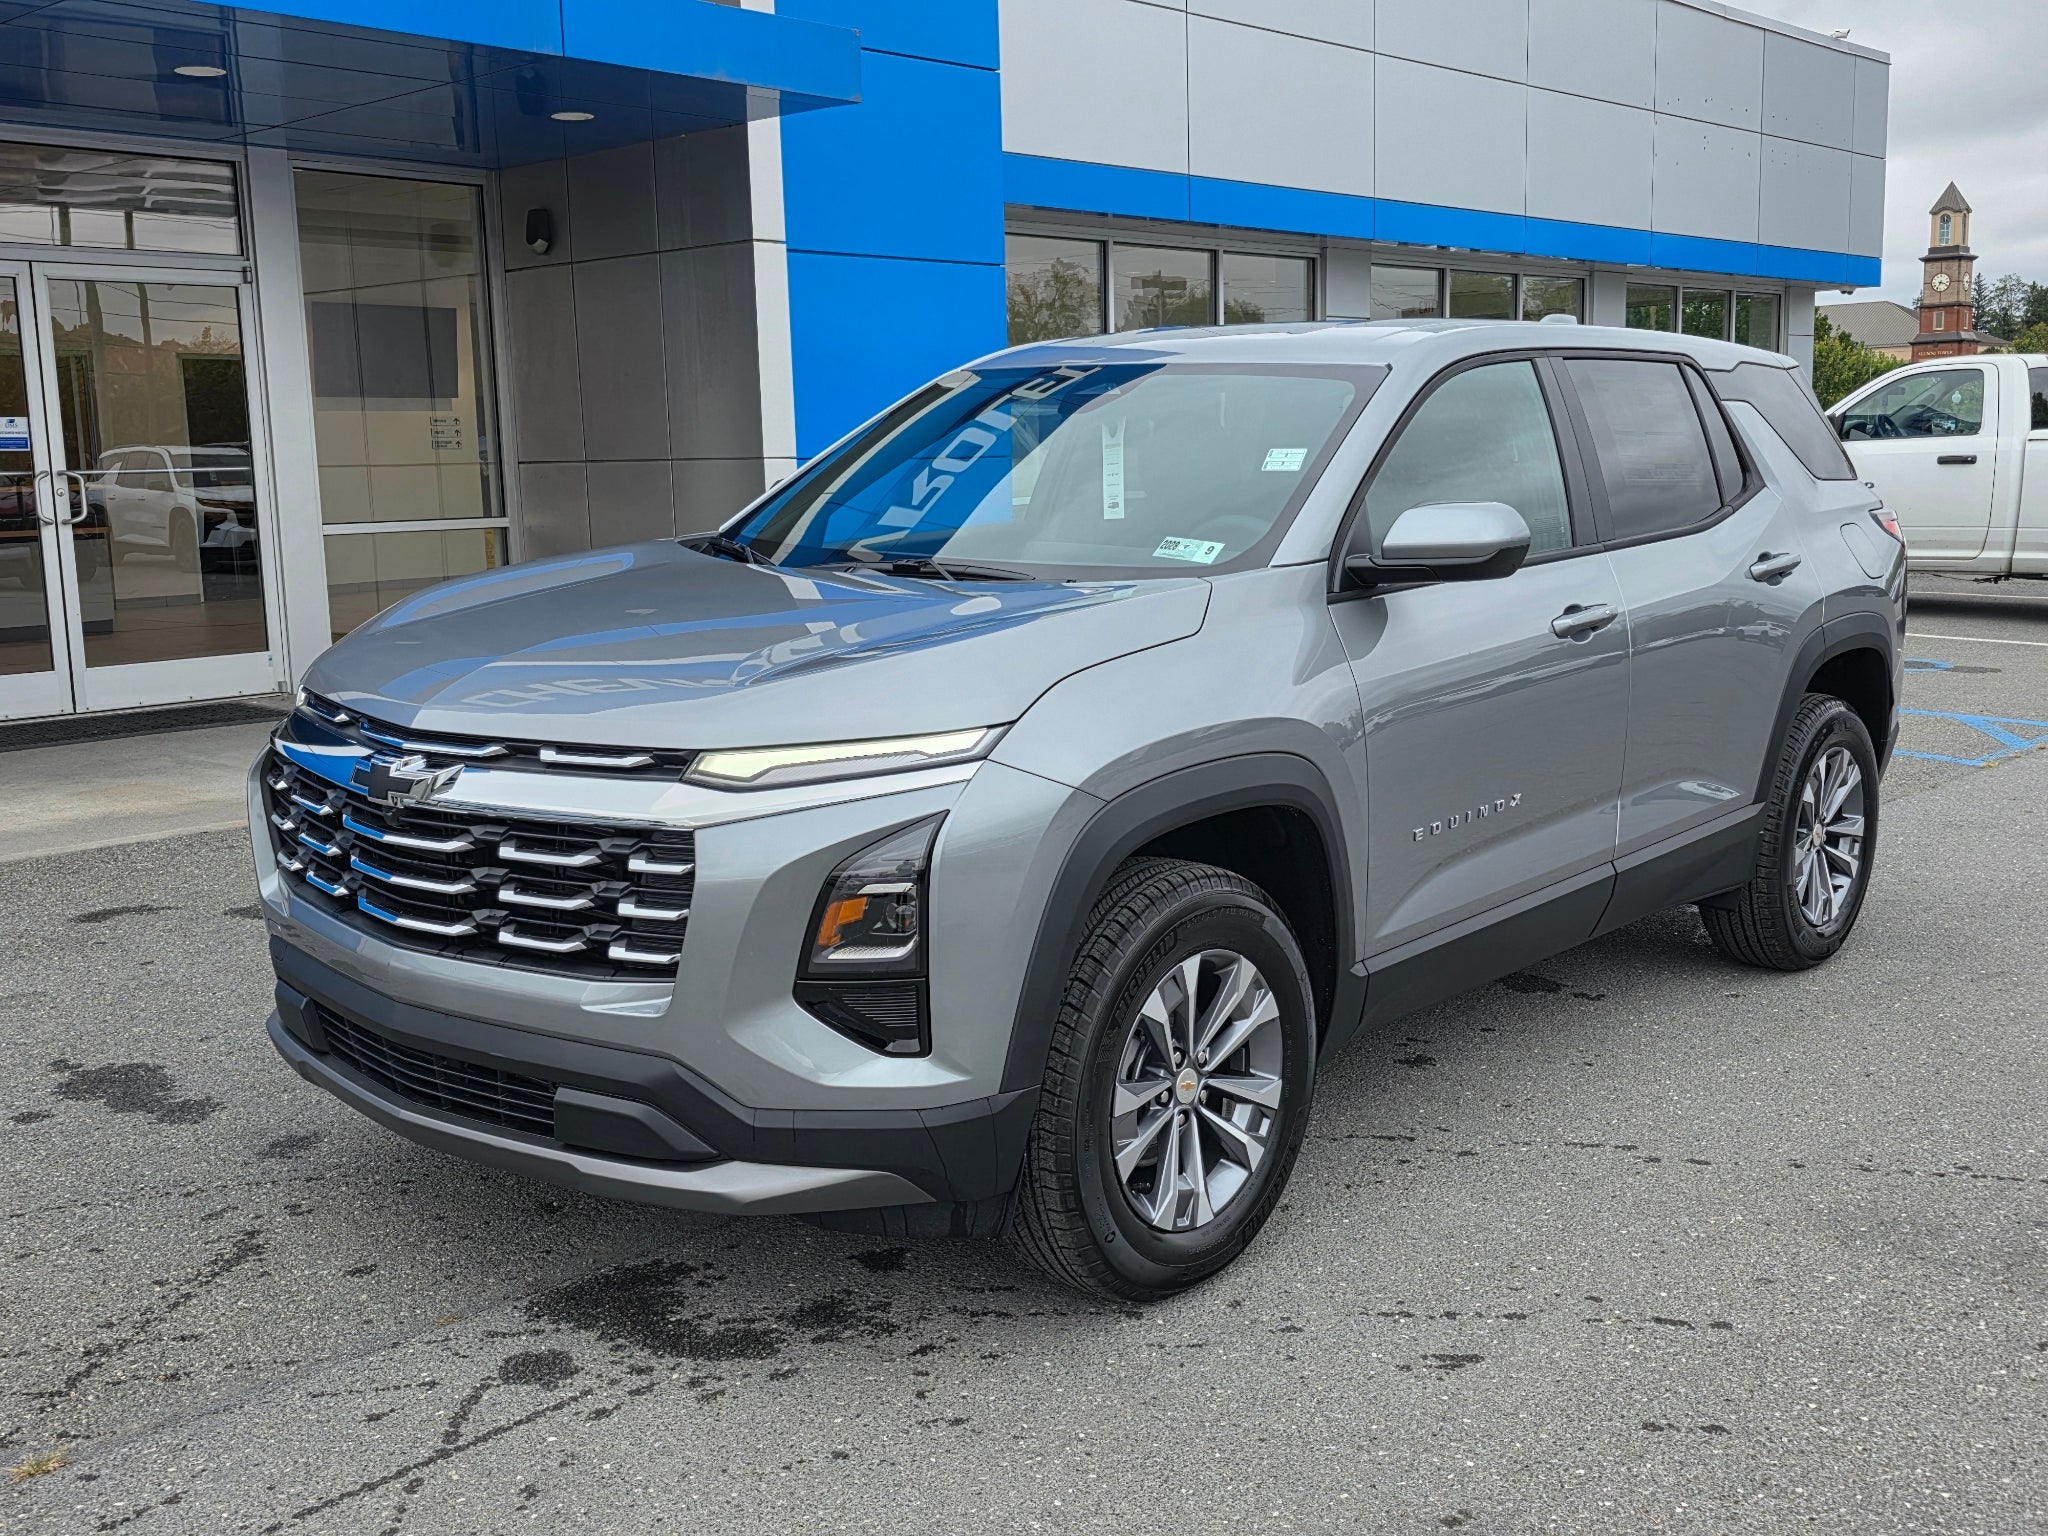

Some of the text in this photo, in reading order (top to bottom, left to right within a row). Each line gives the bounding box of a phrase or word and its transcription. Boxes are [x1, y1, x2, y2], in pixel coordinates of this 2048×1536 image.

[1205, 546, 1215, 555] 9
[1412, 793, 1521, 841] EQUINOX
[1114, 930, 1177, 1026] MICHELIN
